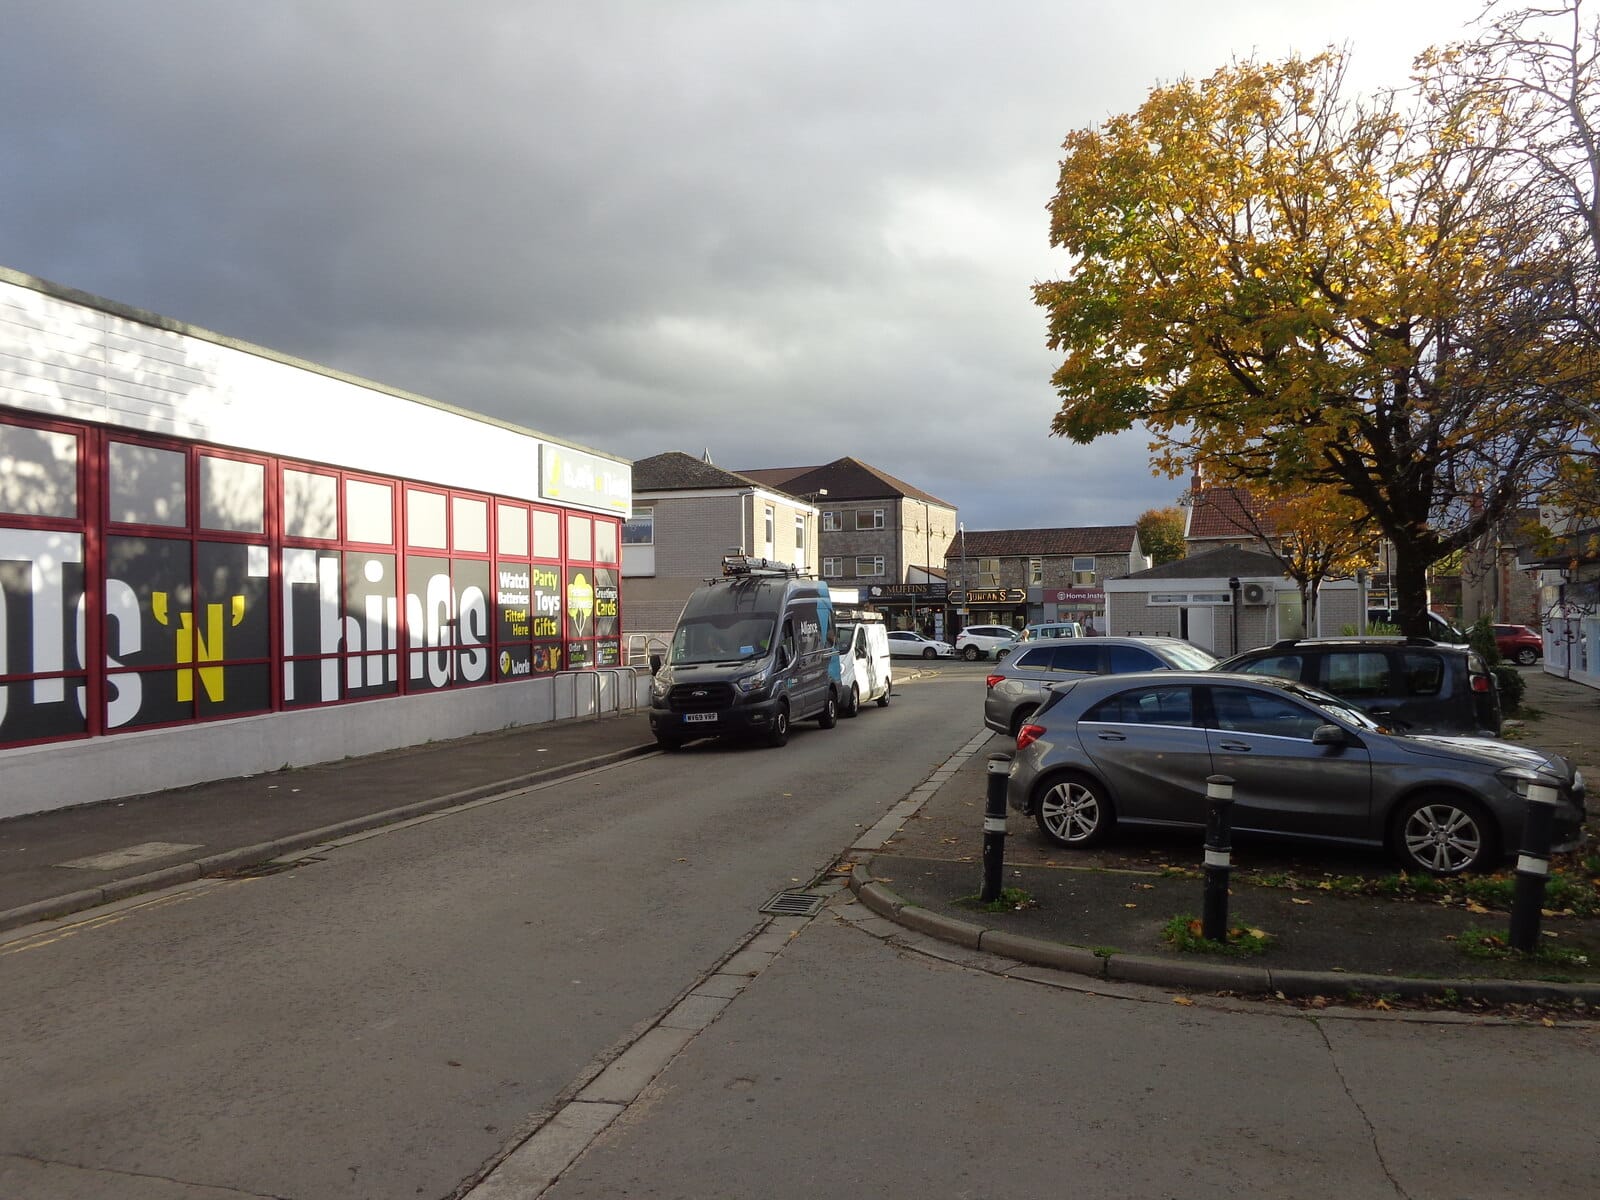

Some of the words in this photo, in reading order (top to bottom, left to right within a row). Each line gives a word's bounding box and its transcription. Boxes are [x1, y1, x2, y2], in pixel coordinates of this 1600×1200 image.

[499, 572, 529, 588] Watch
[533, 568, 558, 591] Party
[596, 587, 617, 599] Greetings
[886, 585, 928, 593] MUFFINS
[497, 592, 529, 605] Batteries
[535, 590, 560, 616] Toys
[596, 598, 616, 616] Cards
[505, 608, 526, 622] Fitted
[512, 623, 529, 636] Here
[534, 617, 557, 636] Gifts
[800, 620, 818, 634] Alliance
